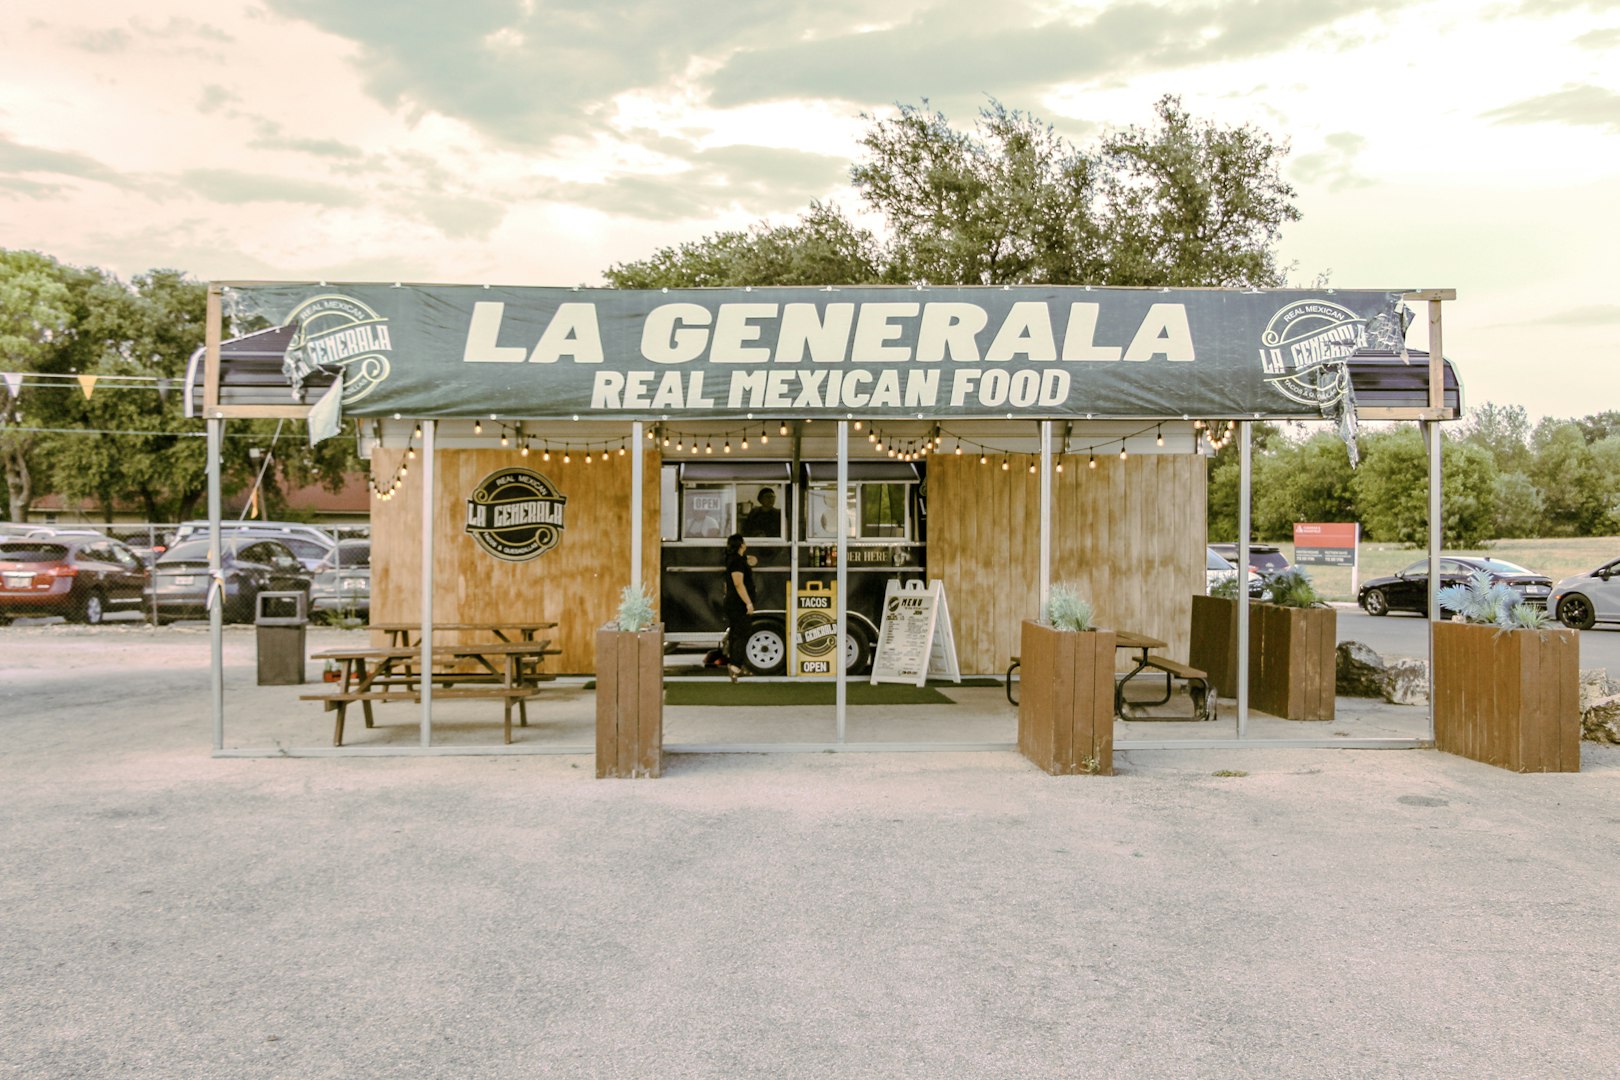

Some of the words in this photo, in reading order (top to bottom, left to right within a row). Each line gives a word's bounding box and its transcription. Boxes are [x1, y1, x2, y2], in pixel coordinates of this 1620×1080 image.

[300, 304, 323, 320] REAL
[323, 301, 365, 320] MEXICAN
[1283, 308, 1304, 322] REAL
[1305, 306, 1345, 320] MEXICAN
[463, 301, 604, 363] LA
[640, 302, 1195, 364] GENERALA
[306, 325, 392, 365] GENERALA
[1259, 348, 1286, 374] LA
[590, 371, 714, 408] REAL
[727, 369, 940, 408] MEXICAN
[950, 369, 1071, 408] FOOD
[1284, 380, 1303, 395] TACOS
[496, 475, 515, 486] REAL
[518, 475, 547, 495] MEXICAN
[695, 498, 719, 509] OPEN
[468, 503, 486, 527] LA
[494, 501, 562, 527] GENERALA
[863, 551, 888, 561] HERE
[800, 597, 828, 607] TACOS
[901, 598, 924, 607] MENU
[803, 662, 827, 672] OPEN
